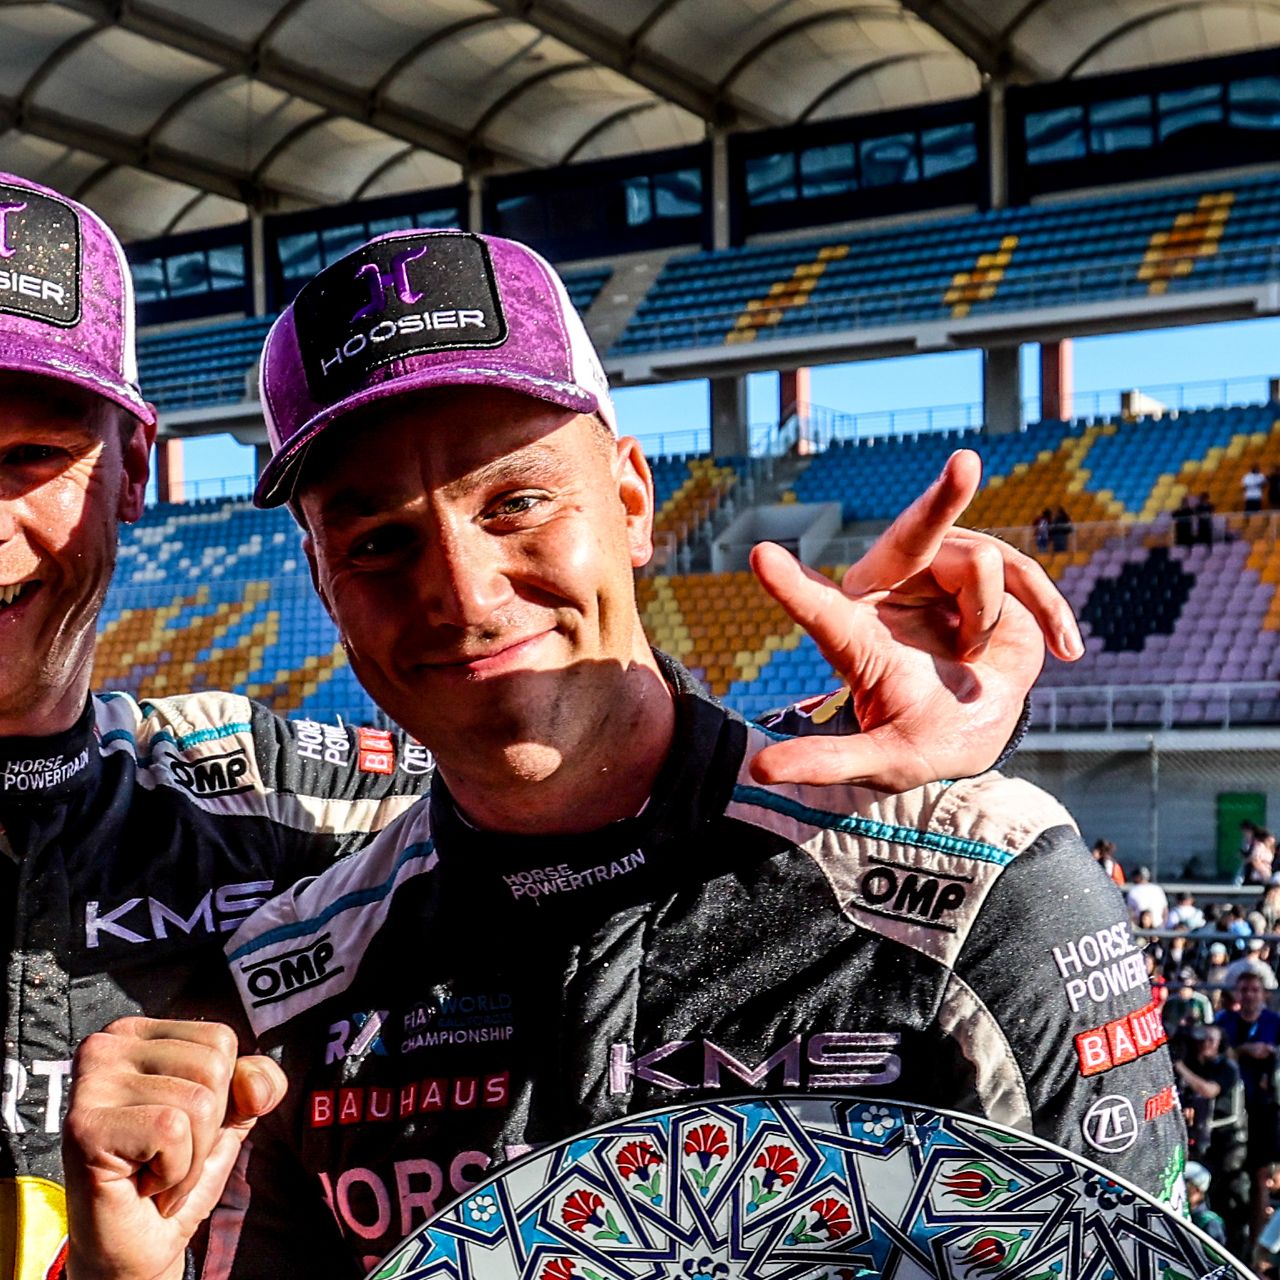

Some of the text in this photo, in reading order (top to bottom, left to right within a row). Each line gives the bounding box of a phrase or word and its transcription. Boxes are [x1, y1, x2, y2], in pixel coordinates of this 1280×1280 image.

[319, 309, 487, 376] HOOSIER
[3, 746, 90, 791] POWERTRAIN
[6, 754, 65, 774] HORSE
[173, 753, 251, 794] OMP
[502, 862, 574, 886] HORSE
[510, 847, 646, 900] POWERTRAIN
[860, 866, 968, 921] OMP
[85, 880, 278, 949] KMS
[246, 942, 336, 997] OMP
[1052, 920, 1139, 979] HORSE
[436, 992, 513, 1015] WORLD
[400, 1026, 515, 1055] CHAMPIONSHIP
[609, 1031, 903, 1094] KMS
[312, 1075, 507, 1122] BAUHAUS
[1085, 1098, 1137, 1150] ZF
[318, 1144, 536, 1240] ORS
